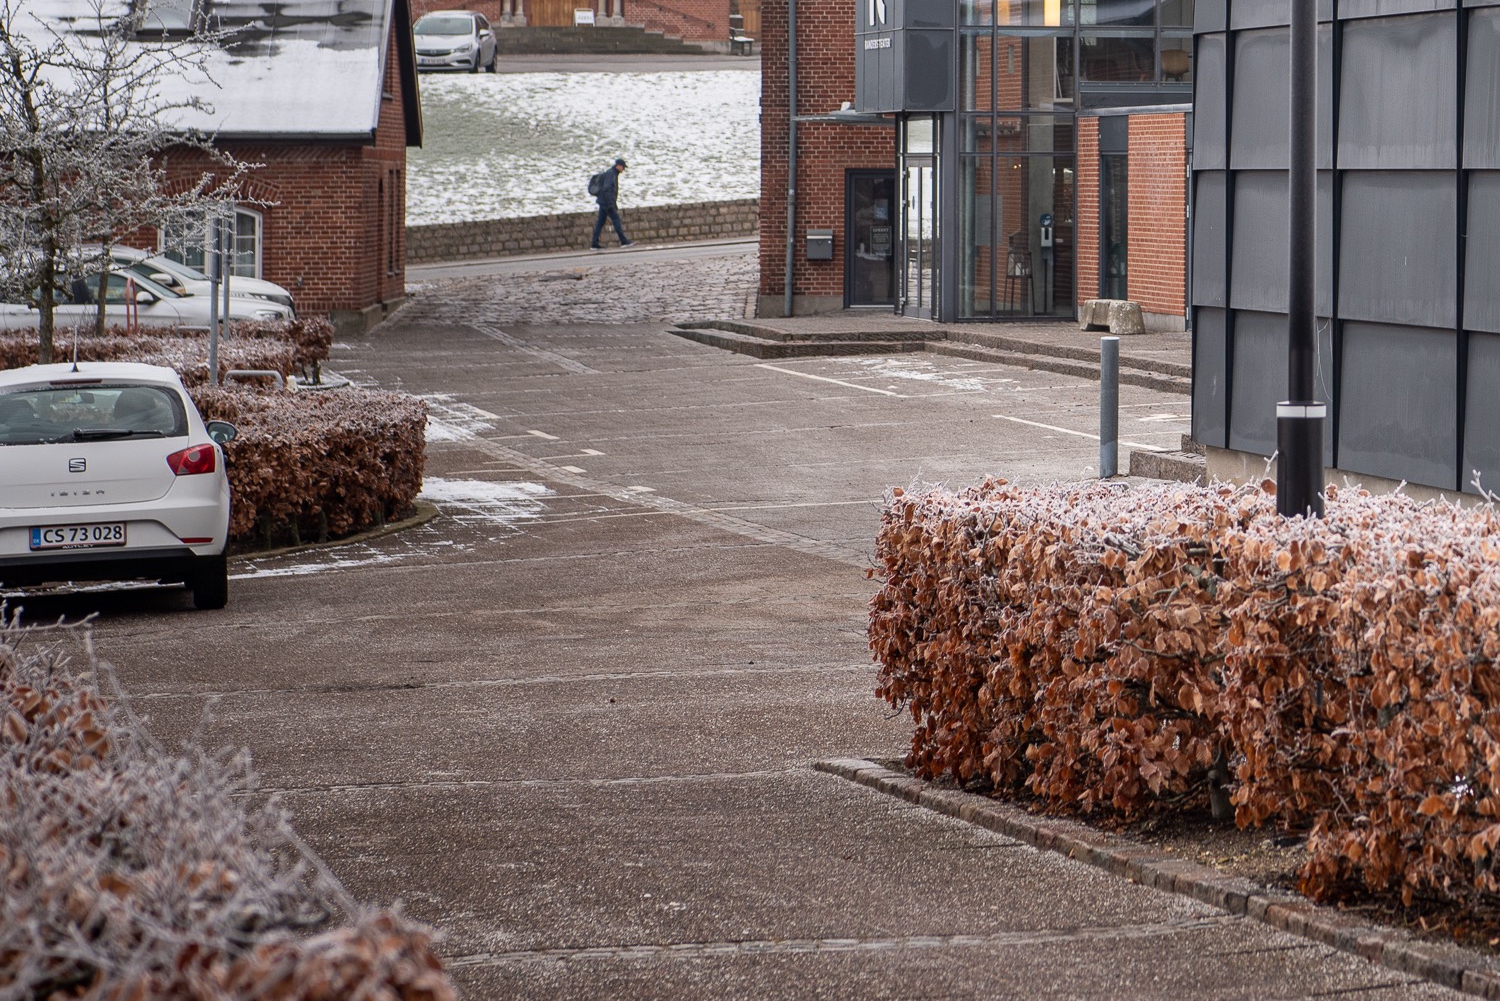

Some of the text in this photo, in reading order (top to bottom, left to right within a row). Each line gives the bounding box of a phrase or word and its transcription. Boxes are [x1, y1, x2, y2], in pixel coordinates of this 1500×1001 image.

[43, 529, 65, 543] CS
[69, 527, 88, 542] 73
[93, 525, 122, 541] 028
